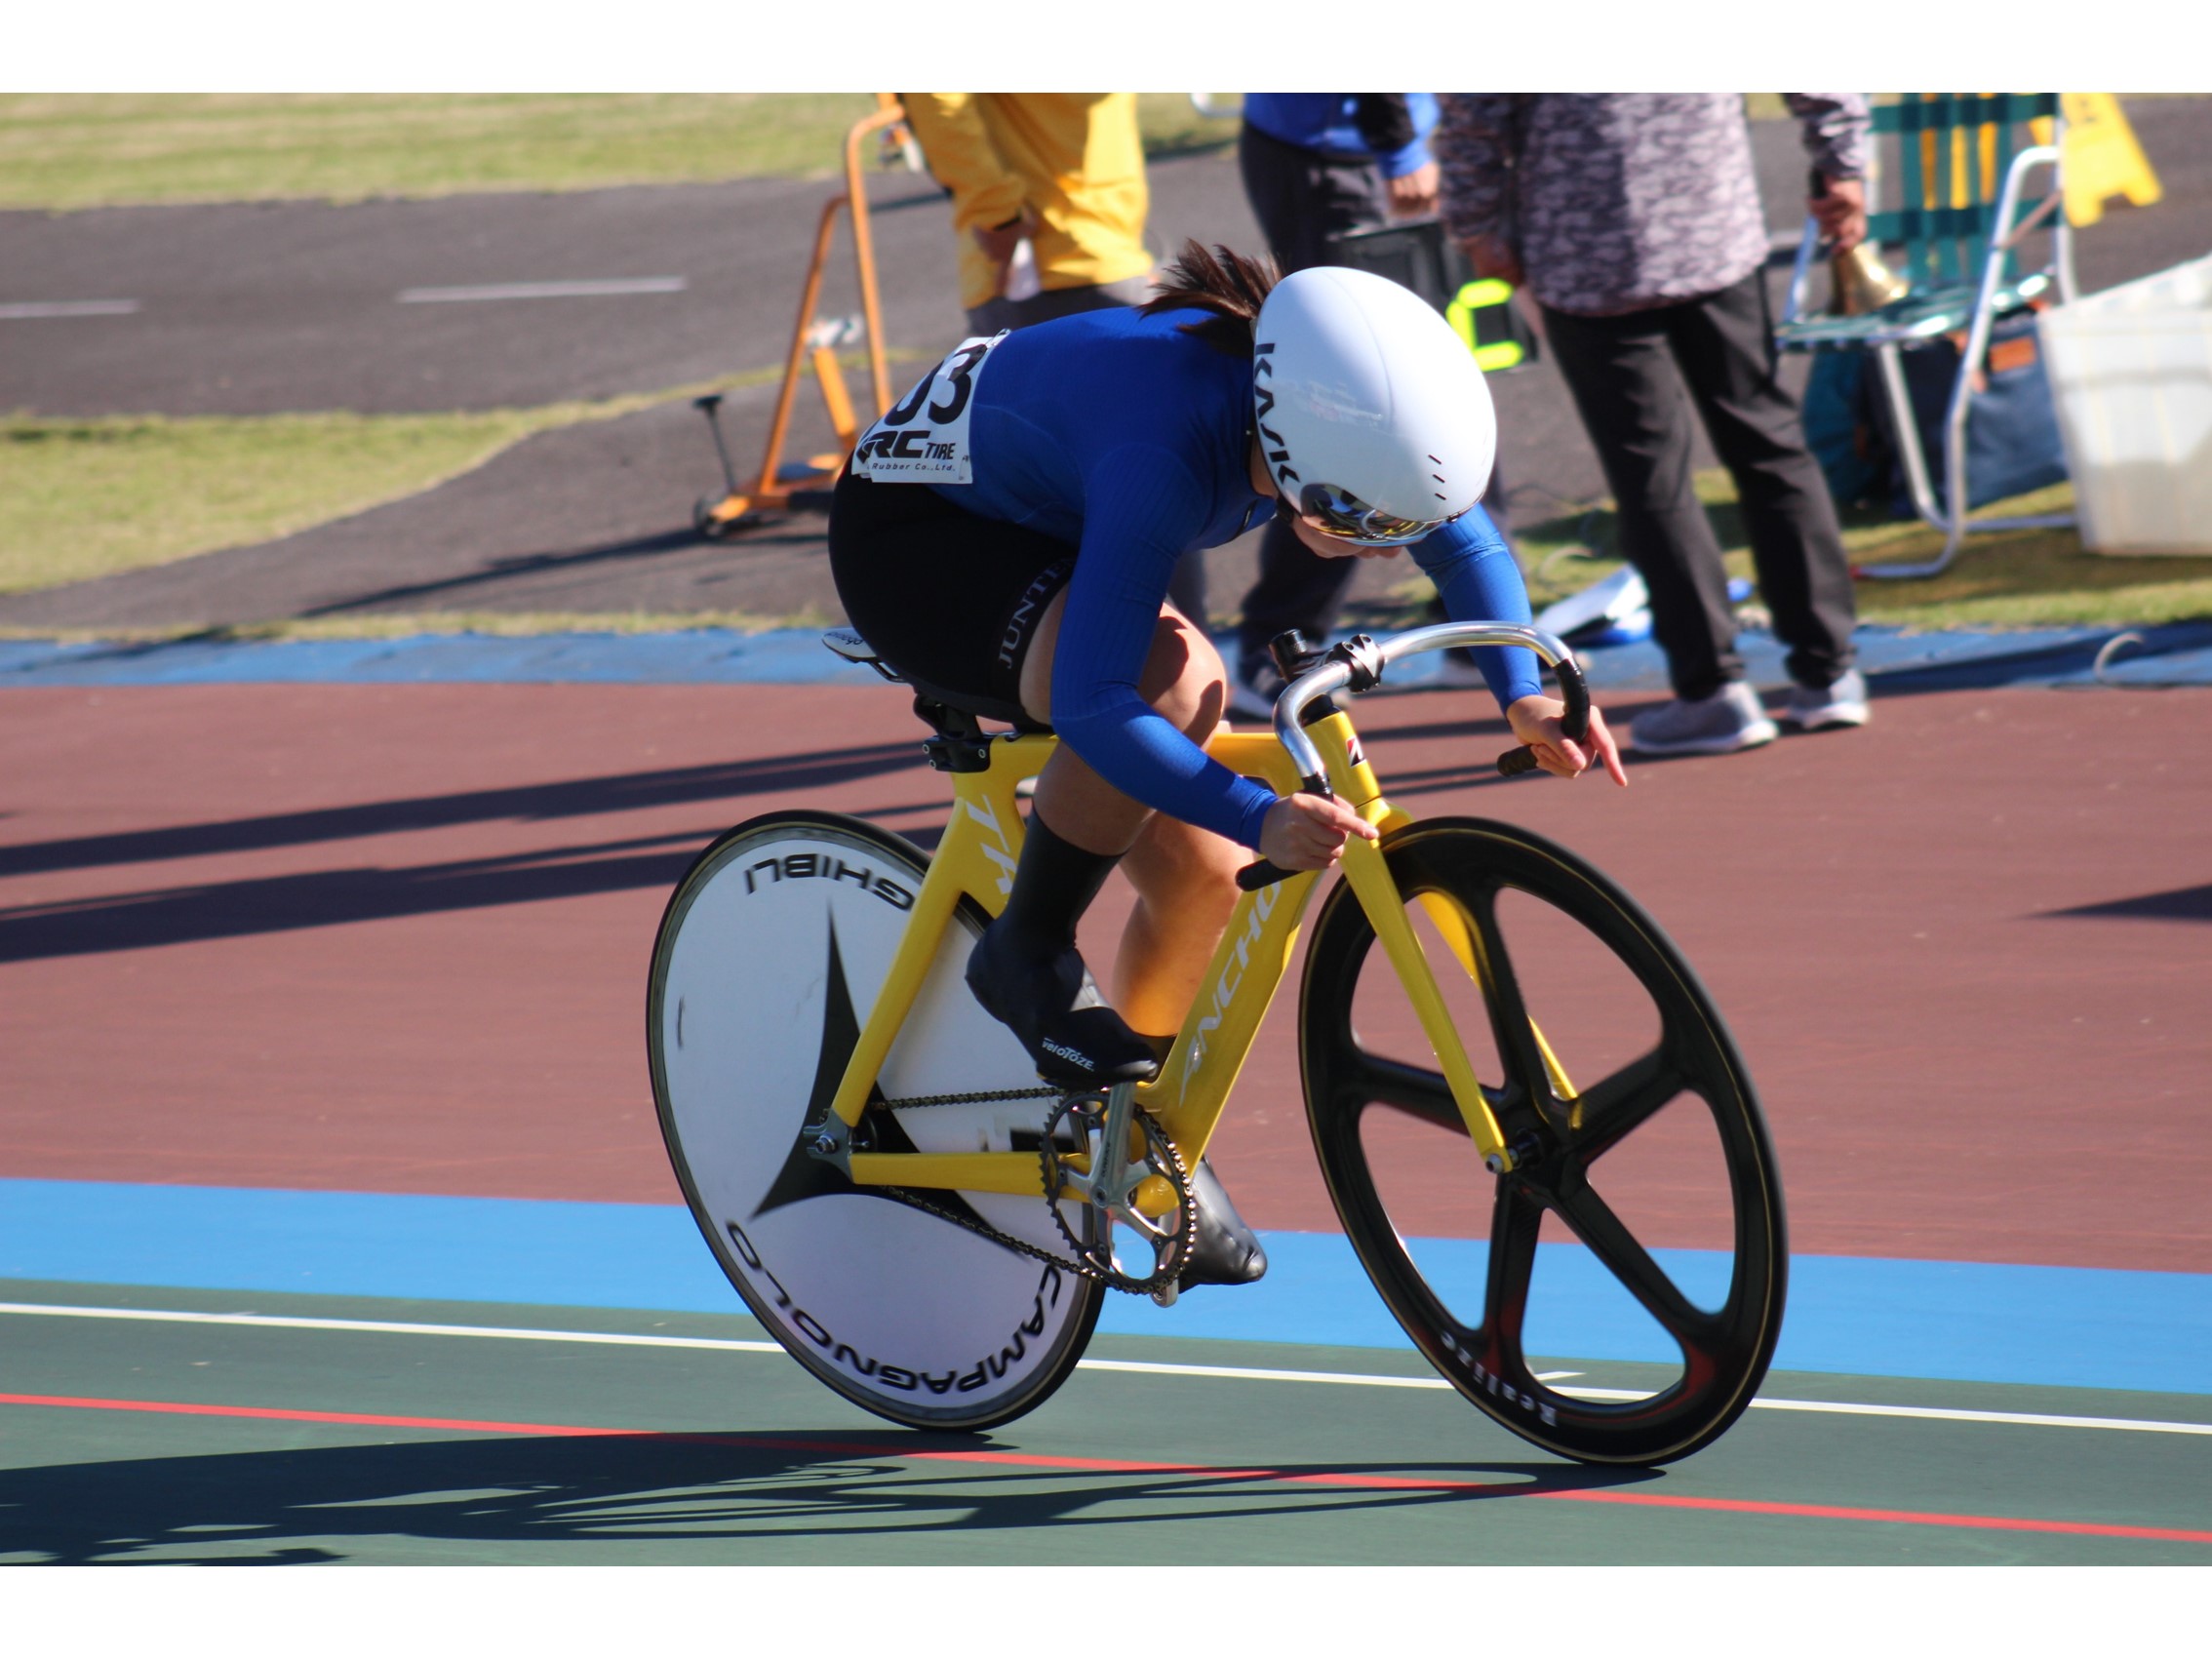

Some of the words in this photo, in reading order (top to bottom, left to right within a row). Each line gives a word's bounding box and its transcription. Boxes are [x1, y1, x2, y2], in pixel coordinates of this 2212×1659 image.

[925, 442, 956, 459] TIRE
[1254, 343, 1301, 485] KASK
[744, 853, 916, 913] GHIBLI
[728, 1220, 1062, 1395] CAMPAGNOLO
